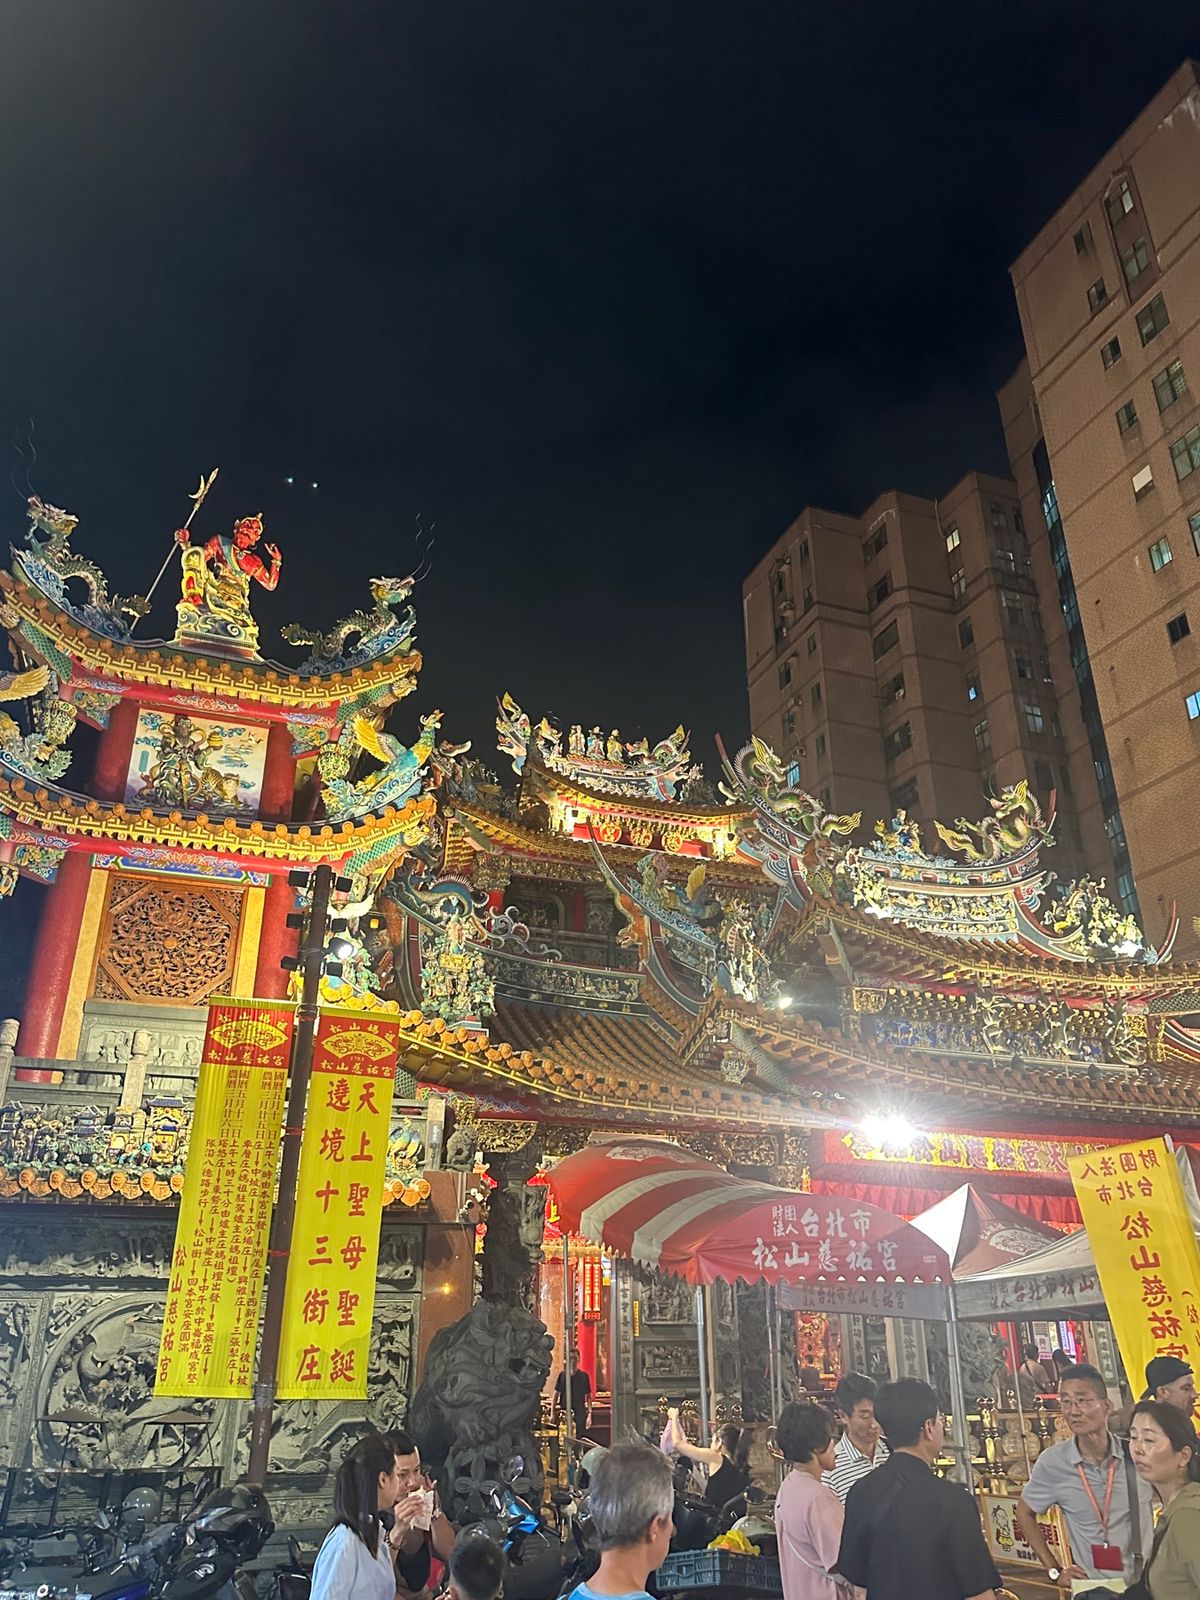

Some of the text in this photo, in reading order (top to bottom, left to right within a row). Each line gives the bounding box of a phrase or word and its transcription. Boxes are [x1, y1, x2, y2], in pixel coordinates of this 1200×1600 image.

[330, 1022, 395, 1044] 松山媽祖
[208, 1051, 285, 1067] 松山慈祐宮
[320, 1060, 394, 1077] 松山慈祐宮
[856, 1133, 1112, 1173] 松山慈祐宮天
[296, 1078, 351, 1383] 遶境十三街庄
[329, 1082, 380, 1384] 天上聖母聖誕
[800, 1207, 873, 1238] 台北市
[752, 1237, 899, 1272] 松山慈祐宮
[1014, 1274, 1101, 1302] 台北市松山
[159, 1244, 188, 1382] 松山慈祐宮
